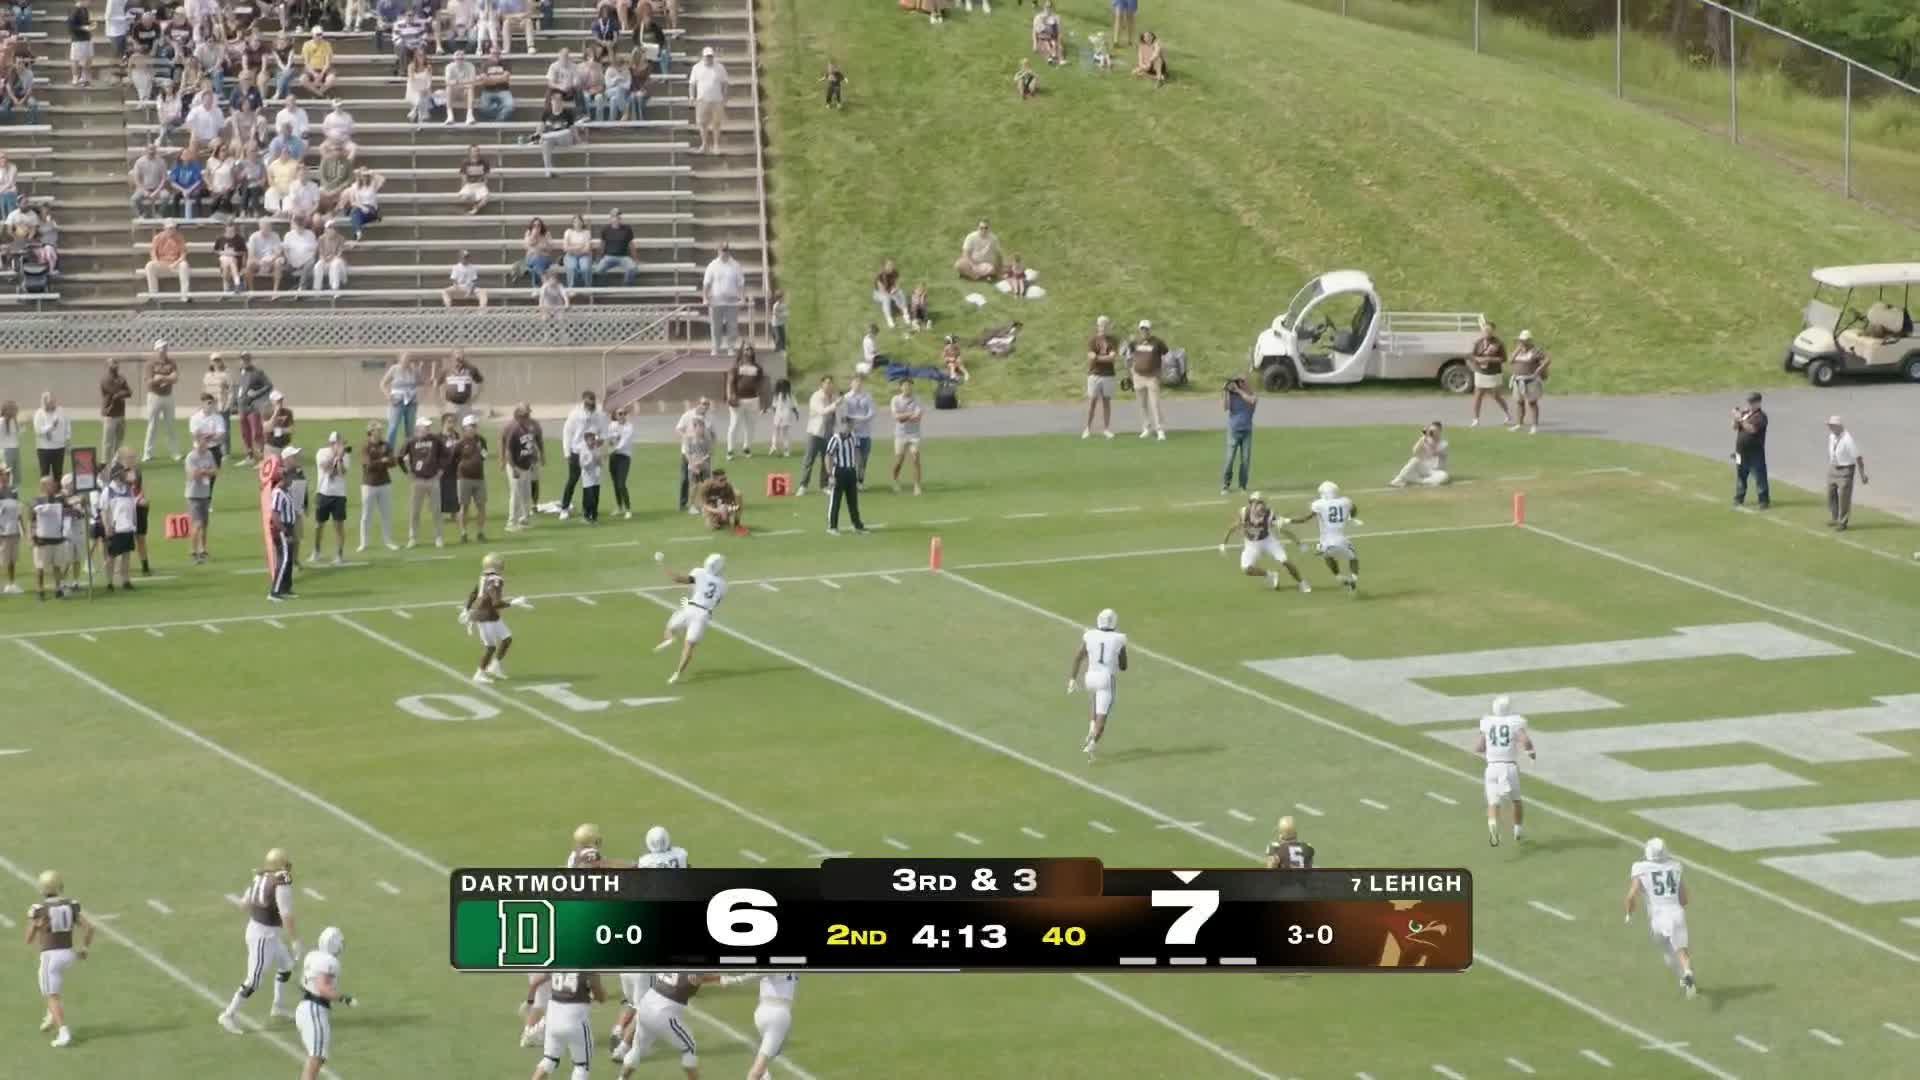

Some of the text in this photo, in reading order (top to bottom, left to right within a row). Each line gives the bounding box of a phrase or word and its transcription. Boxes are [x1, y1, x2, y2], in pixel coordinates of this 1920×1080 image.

[772, 476, 786, 496] G
[1328, 505, 1344, 523] 21
[170, 516, 190, 537] 10
[704, 582, 717, 599] 3
[1098, 642, 1105, 665] 1
[1489, 724, 1510, 747] 49
[1288, 846, 1304, 868] 5
[1651, 869, 1676, 896] 54
